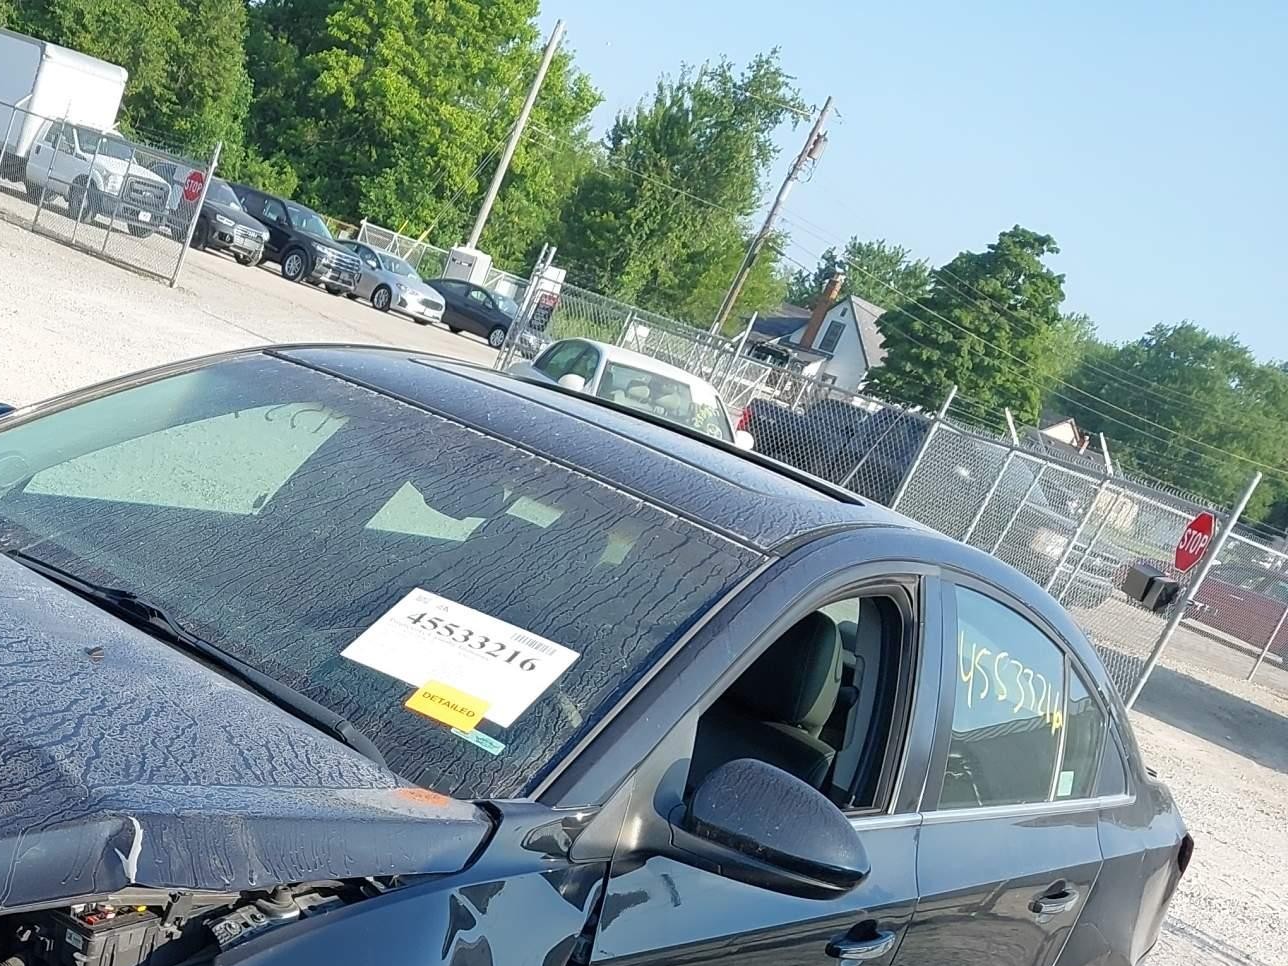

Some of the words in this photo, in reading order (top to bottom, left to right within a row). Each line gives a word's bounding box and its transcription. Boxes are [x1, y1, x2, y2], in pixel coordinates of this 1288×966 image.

[184, 179, 203, 193] STOP
[1179, 528, 1209, 556] STOP
[407, 612, 540, 672] 45533216
[422, 691, 476, 718] DETAILED
